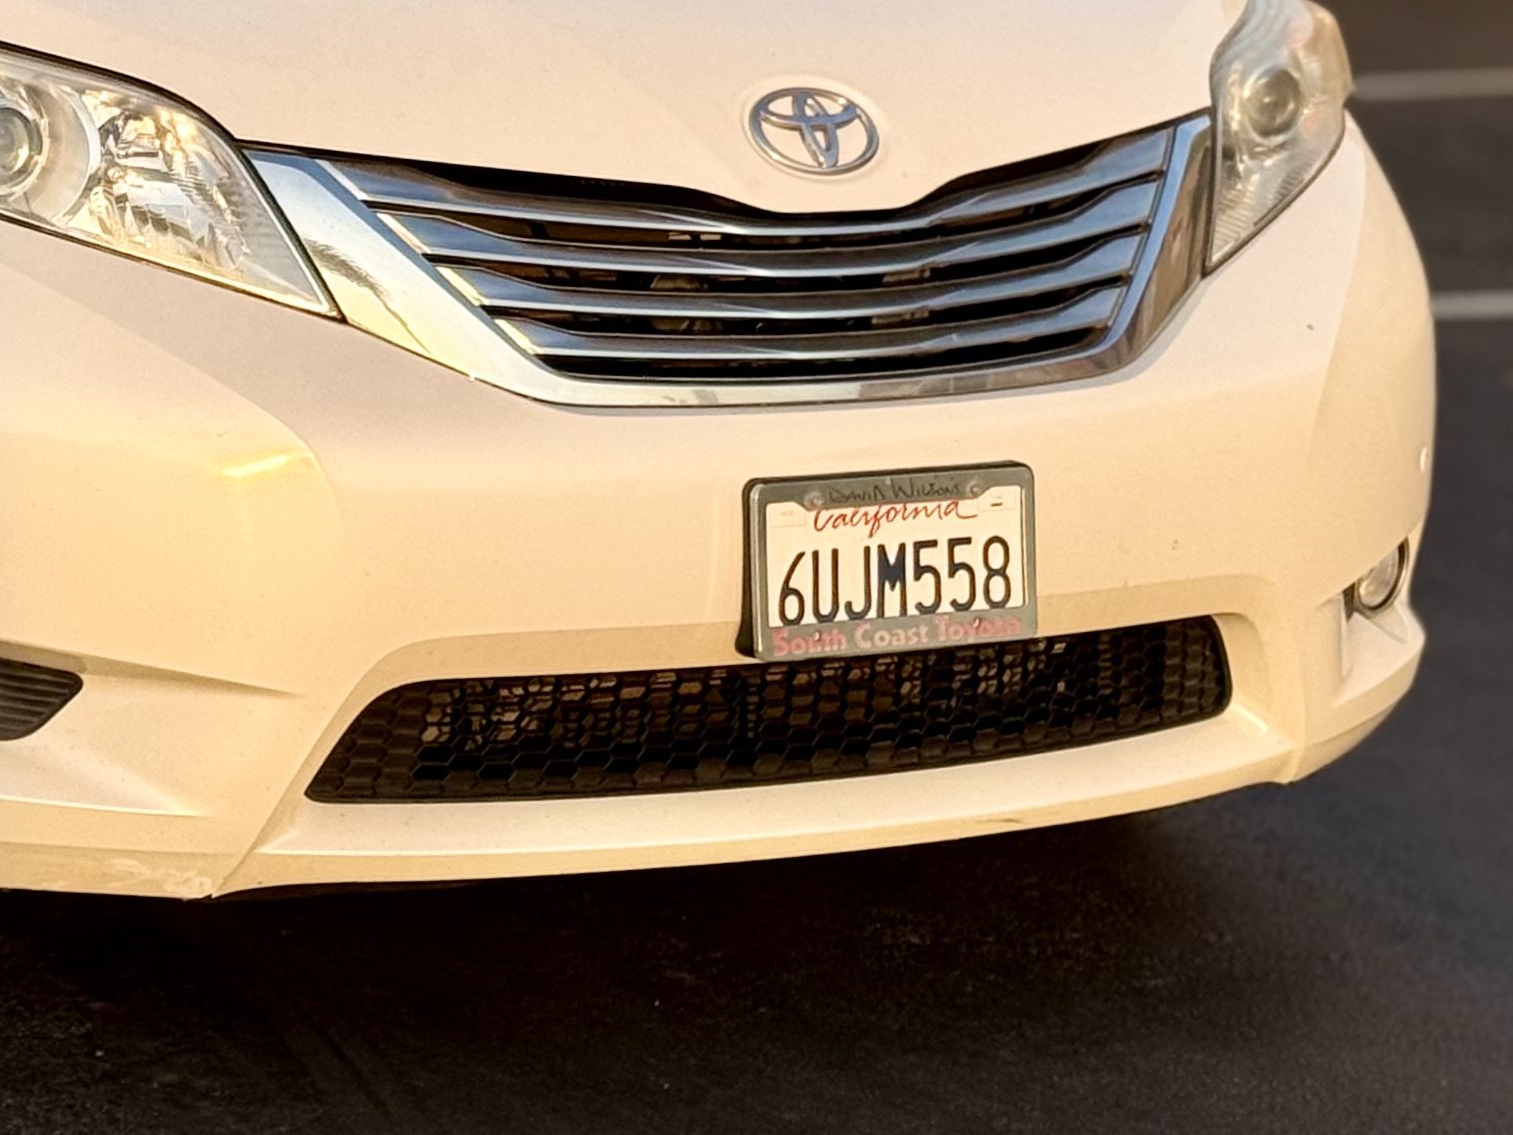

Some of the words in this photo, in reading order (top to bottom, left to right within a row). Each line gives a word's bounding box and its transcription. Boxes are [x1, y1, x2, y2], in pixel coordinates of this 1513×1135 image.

[813, 499, 978, 537] California
[778, 535, 1012, 626] 6UJM558
[772, 627, 847, 657] South
[854, 622, 928, 652] Coast
[935, 614, 1022, 646] Toyota
